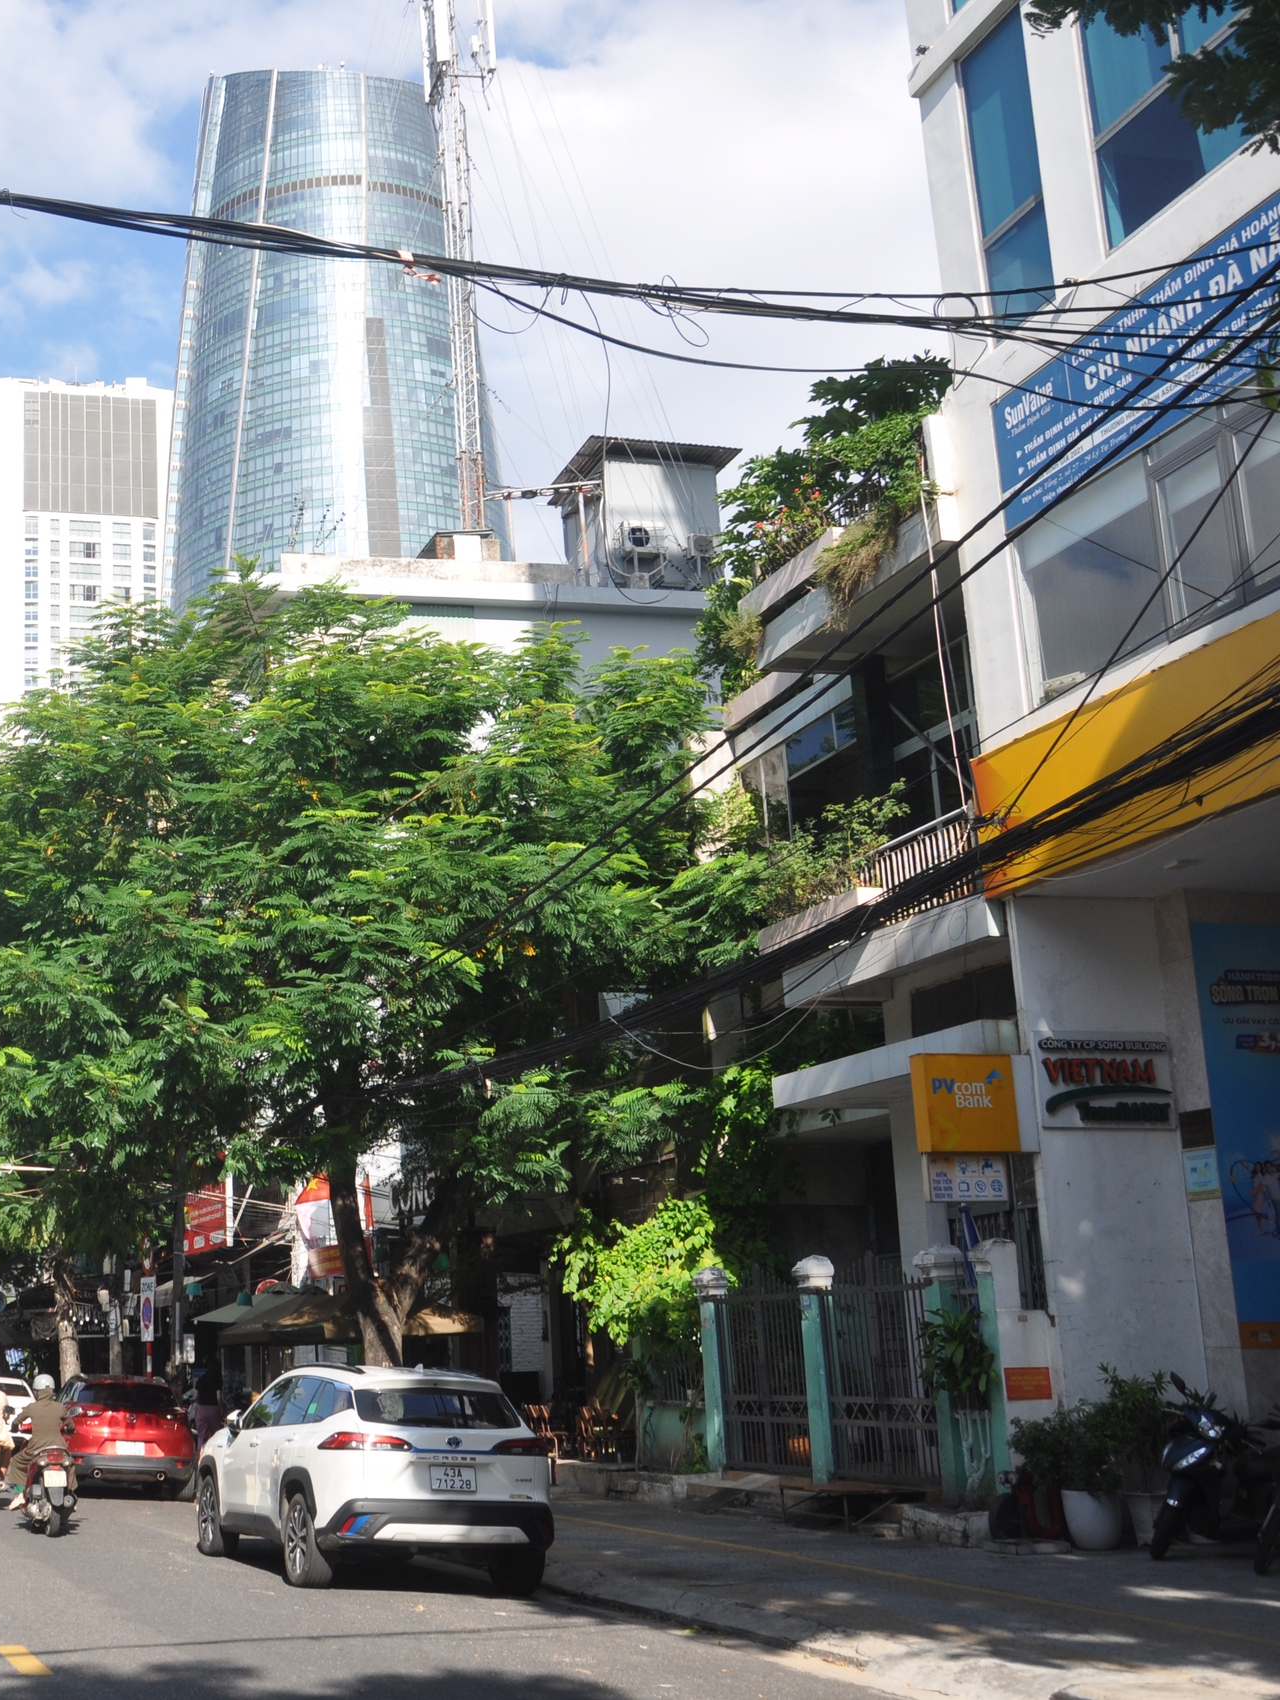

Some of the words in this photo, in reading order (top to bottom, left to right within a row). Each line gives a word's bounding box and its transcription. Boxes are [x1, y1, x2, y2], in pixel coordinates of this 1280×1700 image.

[1148, 277, 1183, 306] THẨM
[1217, 233, 1239, 261] GIÁ
[1084, 349, 1121, 391] CHI
[1125, 288, 1203, 363] NHÁNH
[1208, 259, 1244, 304] ĐÀ
[1004, 381, 1054, 431] SunValue
[1045, 421, 1063, 440] ĐỊNH
[1063, 410, 1077, 427] GIÁ
[1048, 437, 1067, 457] ĐỊNH
[1067, 426, 1081, 443] GIÁ
[1245, 985, 1279, 1005] TRỌN
[1041, 1037, 1068, 1049] CÔNG
[1070, 1040, 1081, 1049] TY
[1083, 1040, 1096, 1049] CP
[1097, 1041, 1124, 1050] SOHO
[1125, 1042, 1167, 1051] BUILDING
[1042, 1057, 1157, 1084] VIETNAM
[931, 1077, 986, 1095] PVcom
[955, 1094, 993, 1108] Bank
[141, 1282, 154, 1293] ZONE
[443, 1467, 463, 1478] 43A
[435, 1478, 472, 1490] 712.28
